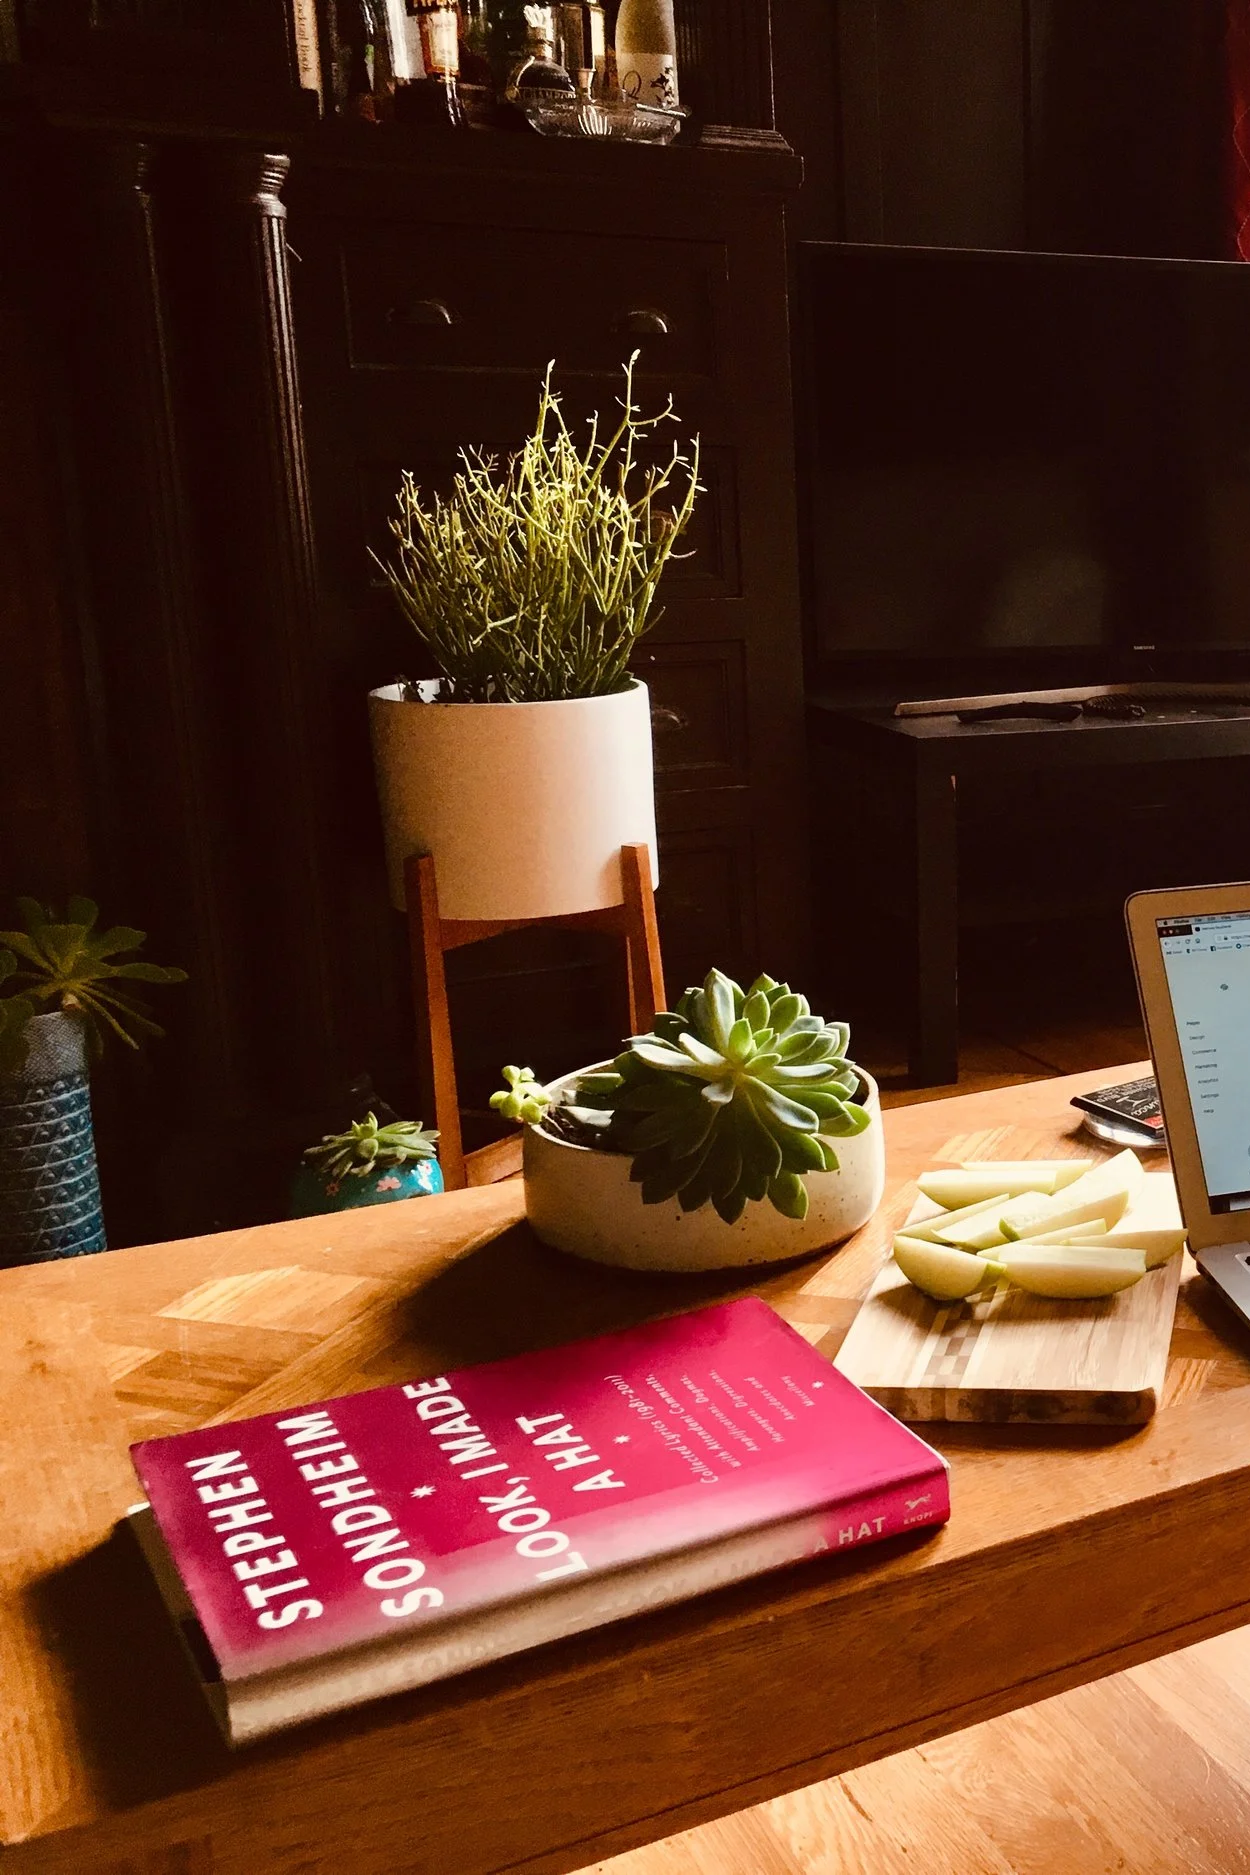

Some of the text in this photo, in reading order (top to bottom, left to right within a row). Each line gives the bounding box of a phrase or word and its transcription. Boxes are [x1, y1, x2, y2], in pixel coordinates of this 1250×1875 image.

[604, 1374, 719, 1484] Collected Lyrics (1981-2011)
[647, 1373, 742, 1468] with Attendant Comments,
[744, 1376, 761, 1389] and
[401, 1377, 589, 1582] LOOK, I MADE
[514, 1412, 627, 1493] A HAT
[185, 1450, 324, 1630] STEPHEN
[275, 1410, 445, 1618] SONDHEIM
[813, 1535, 830, 1553] A
[838, 1515, 887, 1545] HAT
[902, 1511, 934, 1526] KNOPF
